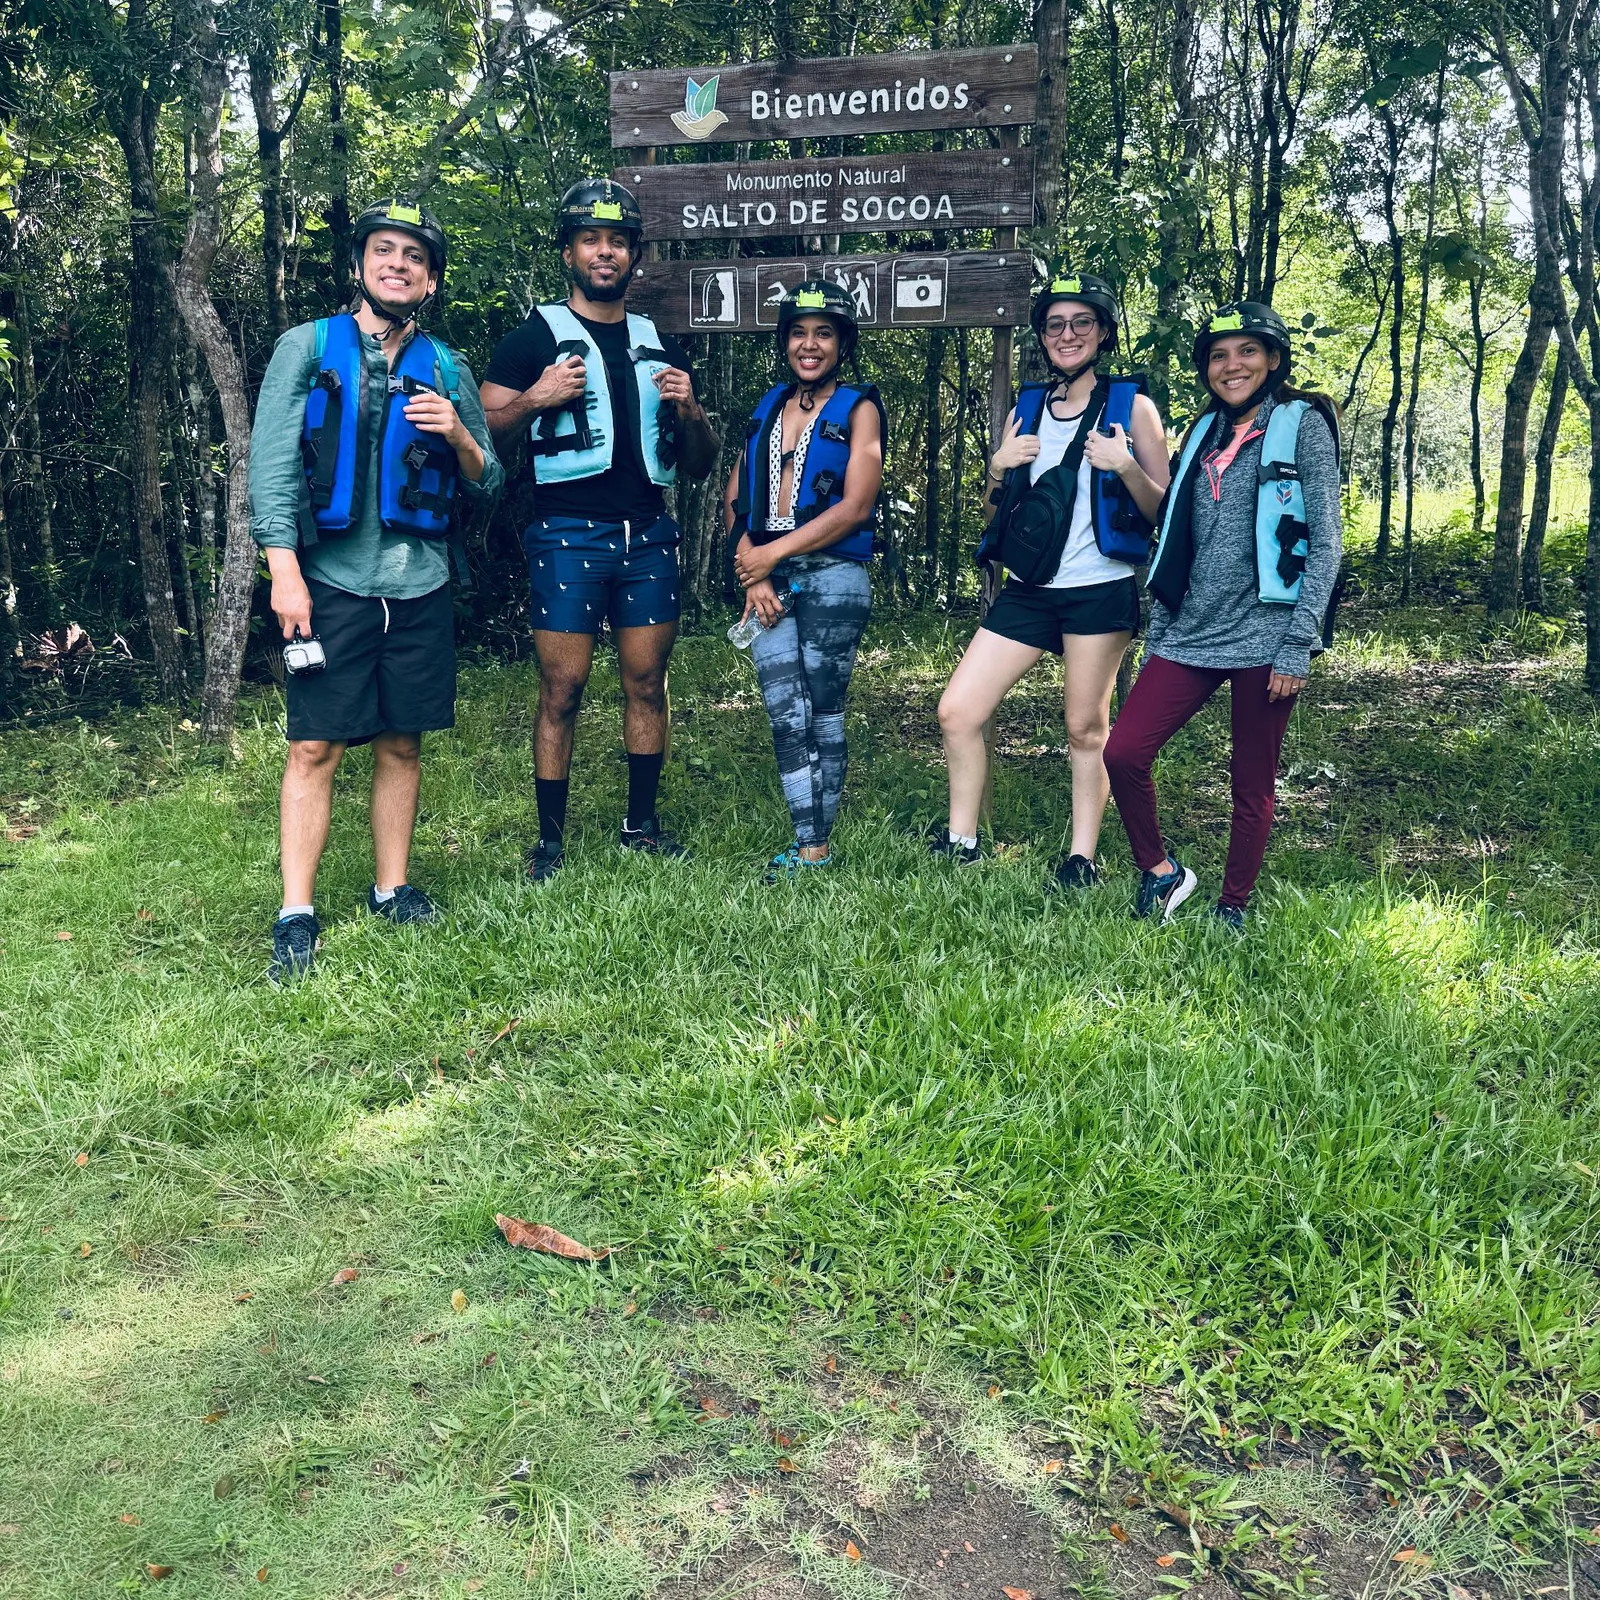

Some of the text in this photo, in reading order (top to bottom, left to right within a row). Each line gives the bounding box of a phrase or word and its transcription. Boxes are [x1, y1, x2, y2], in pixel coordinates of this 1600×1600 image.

[751, 78, 969, 120] Bienvenidos
[726, 165, 906, 192] Monumento Natural
[682, 195, 954, 228] SALTO DE SOCOA
